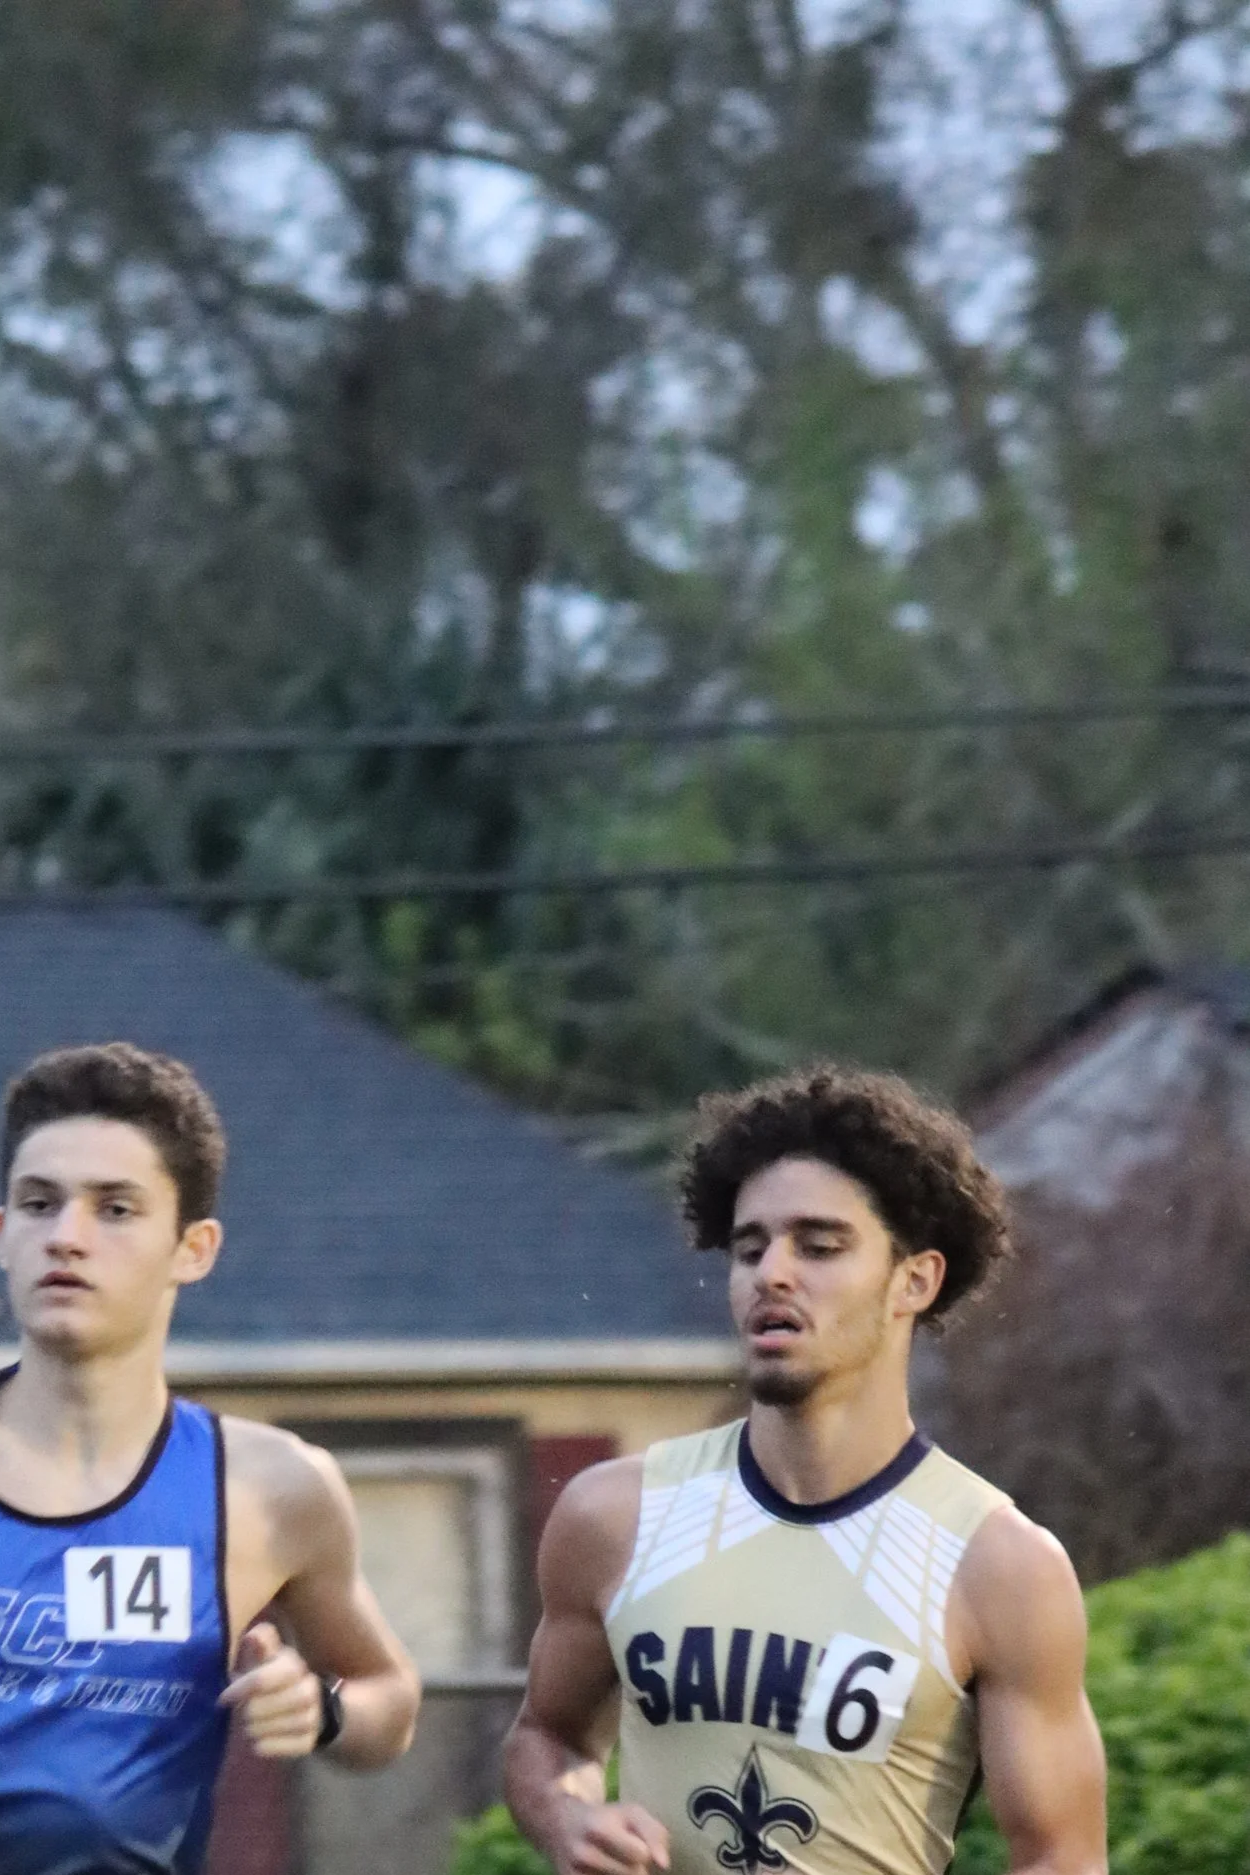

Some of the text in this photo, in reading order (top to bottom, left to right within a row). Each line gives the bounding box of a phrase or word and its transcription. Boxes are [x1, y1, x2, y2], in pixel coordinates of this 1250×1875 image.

[88, 1554, 170, 1632] 14
[625, 1626, 827, 1734] SAIN
[825, 1650, 895, 1753] 6
